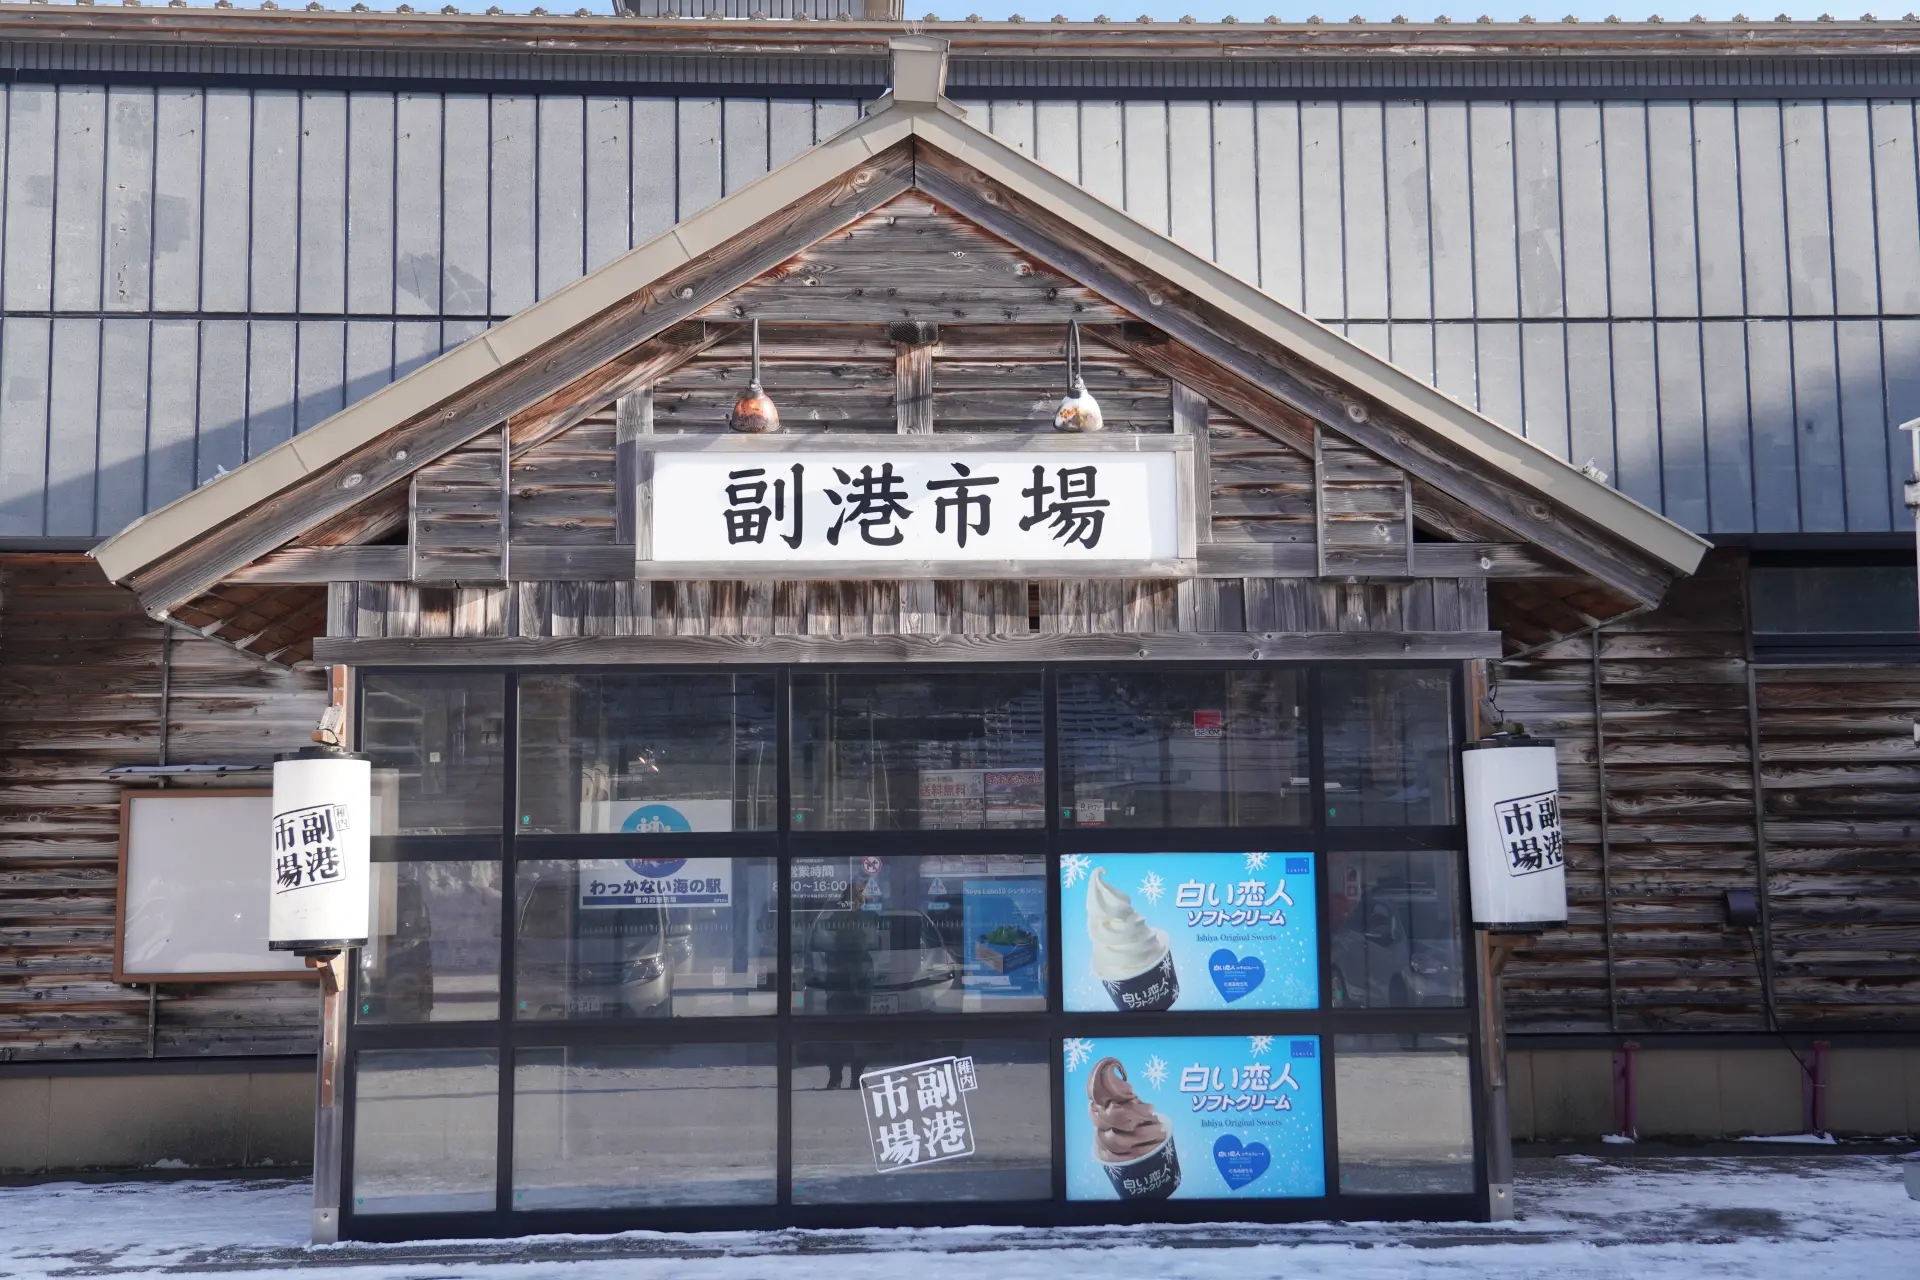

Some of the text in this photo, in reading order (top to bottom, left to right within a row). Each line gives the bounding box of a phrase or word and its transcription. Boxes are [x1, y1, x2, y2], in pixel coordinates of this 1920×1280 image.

[723, 462, 1110, 549] 副港市場
[589, 878, 722, 895] わっかない海の駅
[1176, 878, 1294, 908] 白い恋人
[1187, 909, 1287, 928] ソフトクリーム
[1197, 933, 1277, 943] Ishiya Original Sweets
[1122, 976, 1169, 1003] 白い恋人
[1129, 987, 1169, 1008] ソフトクリーム
[957, 1060, 975, 1089] 稚内
[1180, 1062, 1300, 1092] 白い恋人
[912, 1064, 966, 1157] 副港
[1192, 1093, 1292, 1112] ソフトクリーム
[868, 1075, 921, 1165] 市場
[1201, 1118, 1282, 1128] Ishiya Original Sweets
[1123, 1163, 1171, 1189] 白い恋人
[1129, 1174, 1171, 1195] ソフトクリーム
